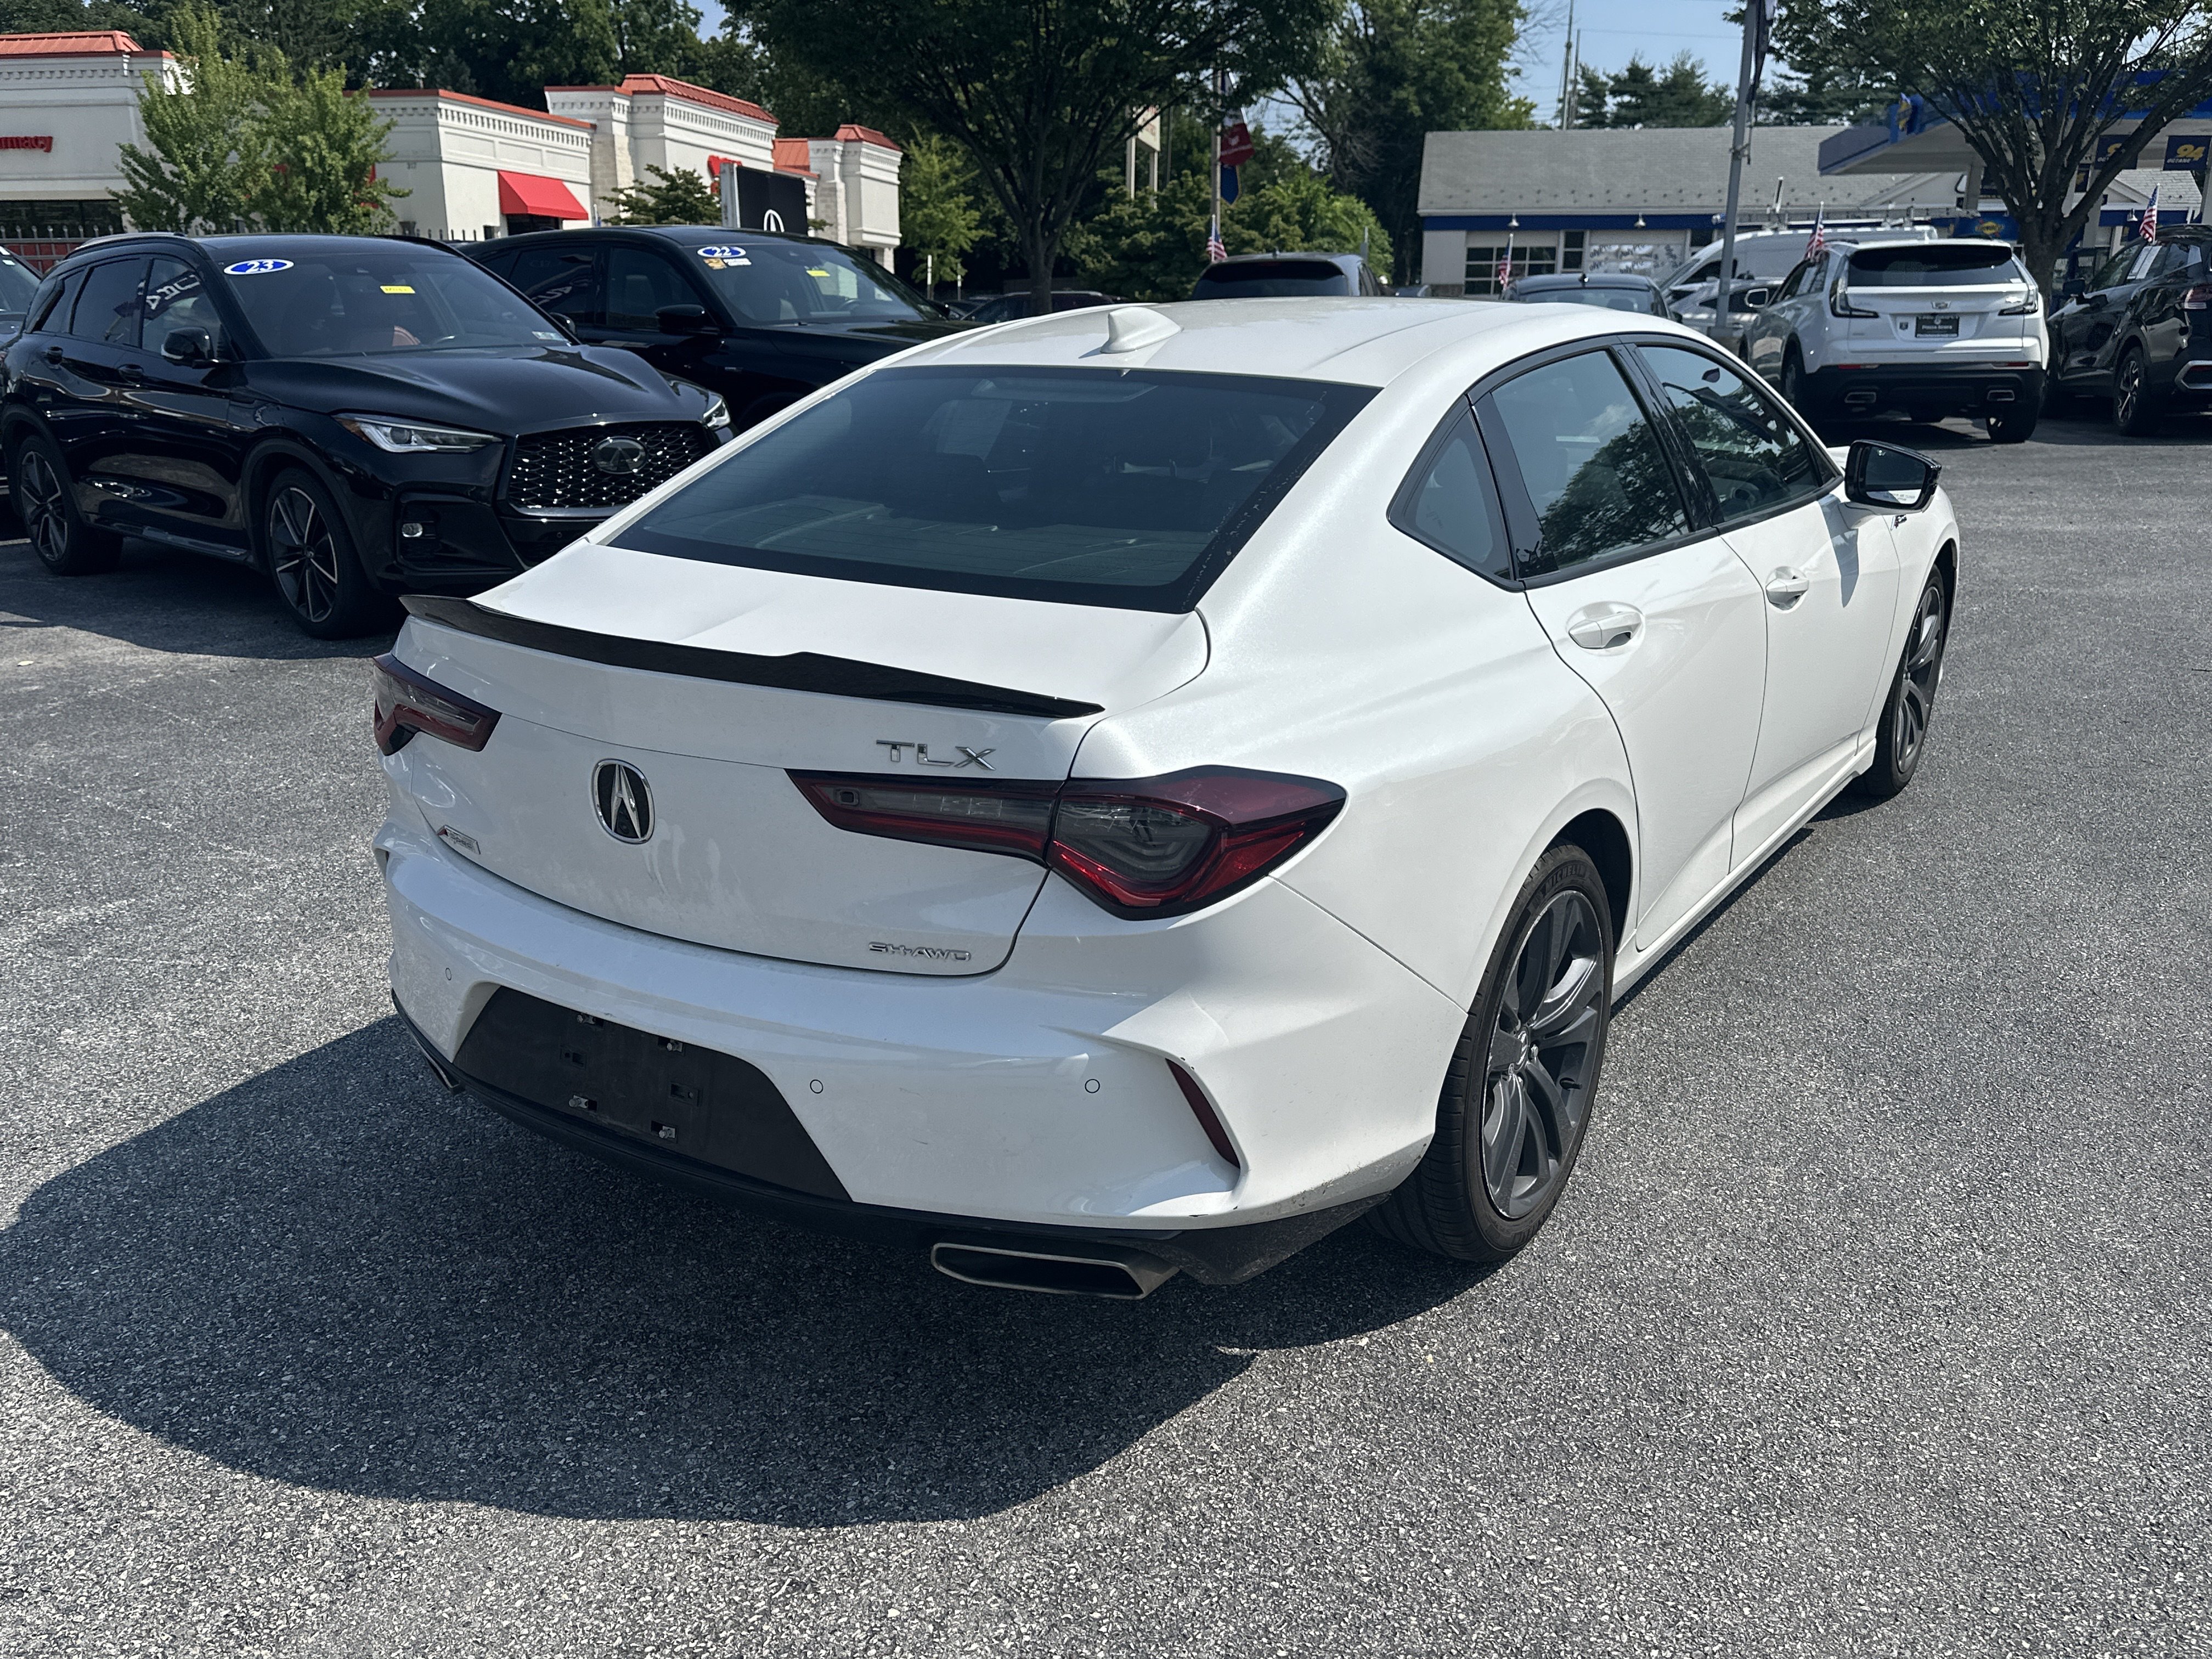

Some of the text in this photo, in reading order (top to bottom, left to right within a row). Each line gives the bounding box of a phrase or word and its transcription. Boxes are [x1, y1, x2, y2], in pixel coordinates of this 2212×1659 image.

[2176, 144, 2205, 161] 94
[712, 246, 732, 256] 22
[245, 260, 274, 273] 23
[876, 740, 996, 770] TLX
[868, 936, 972, 961] SH-AWD
